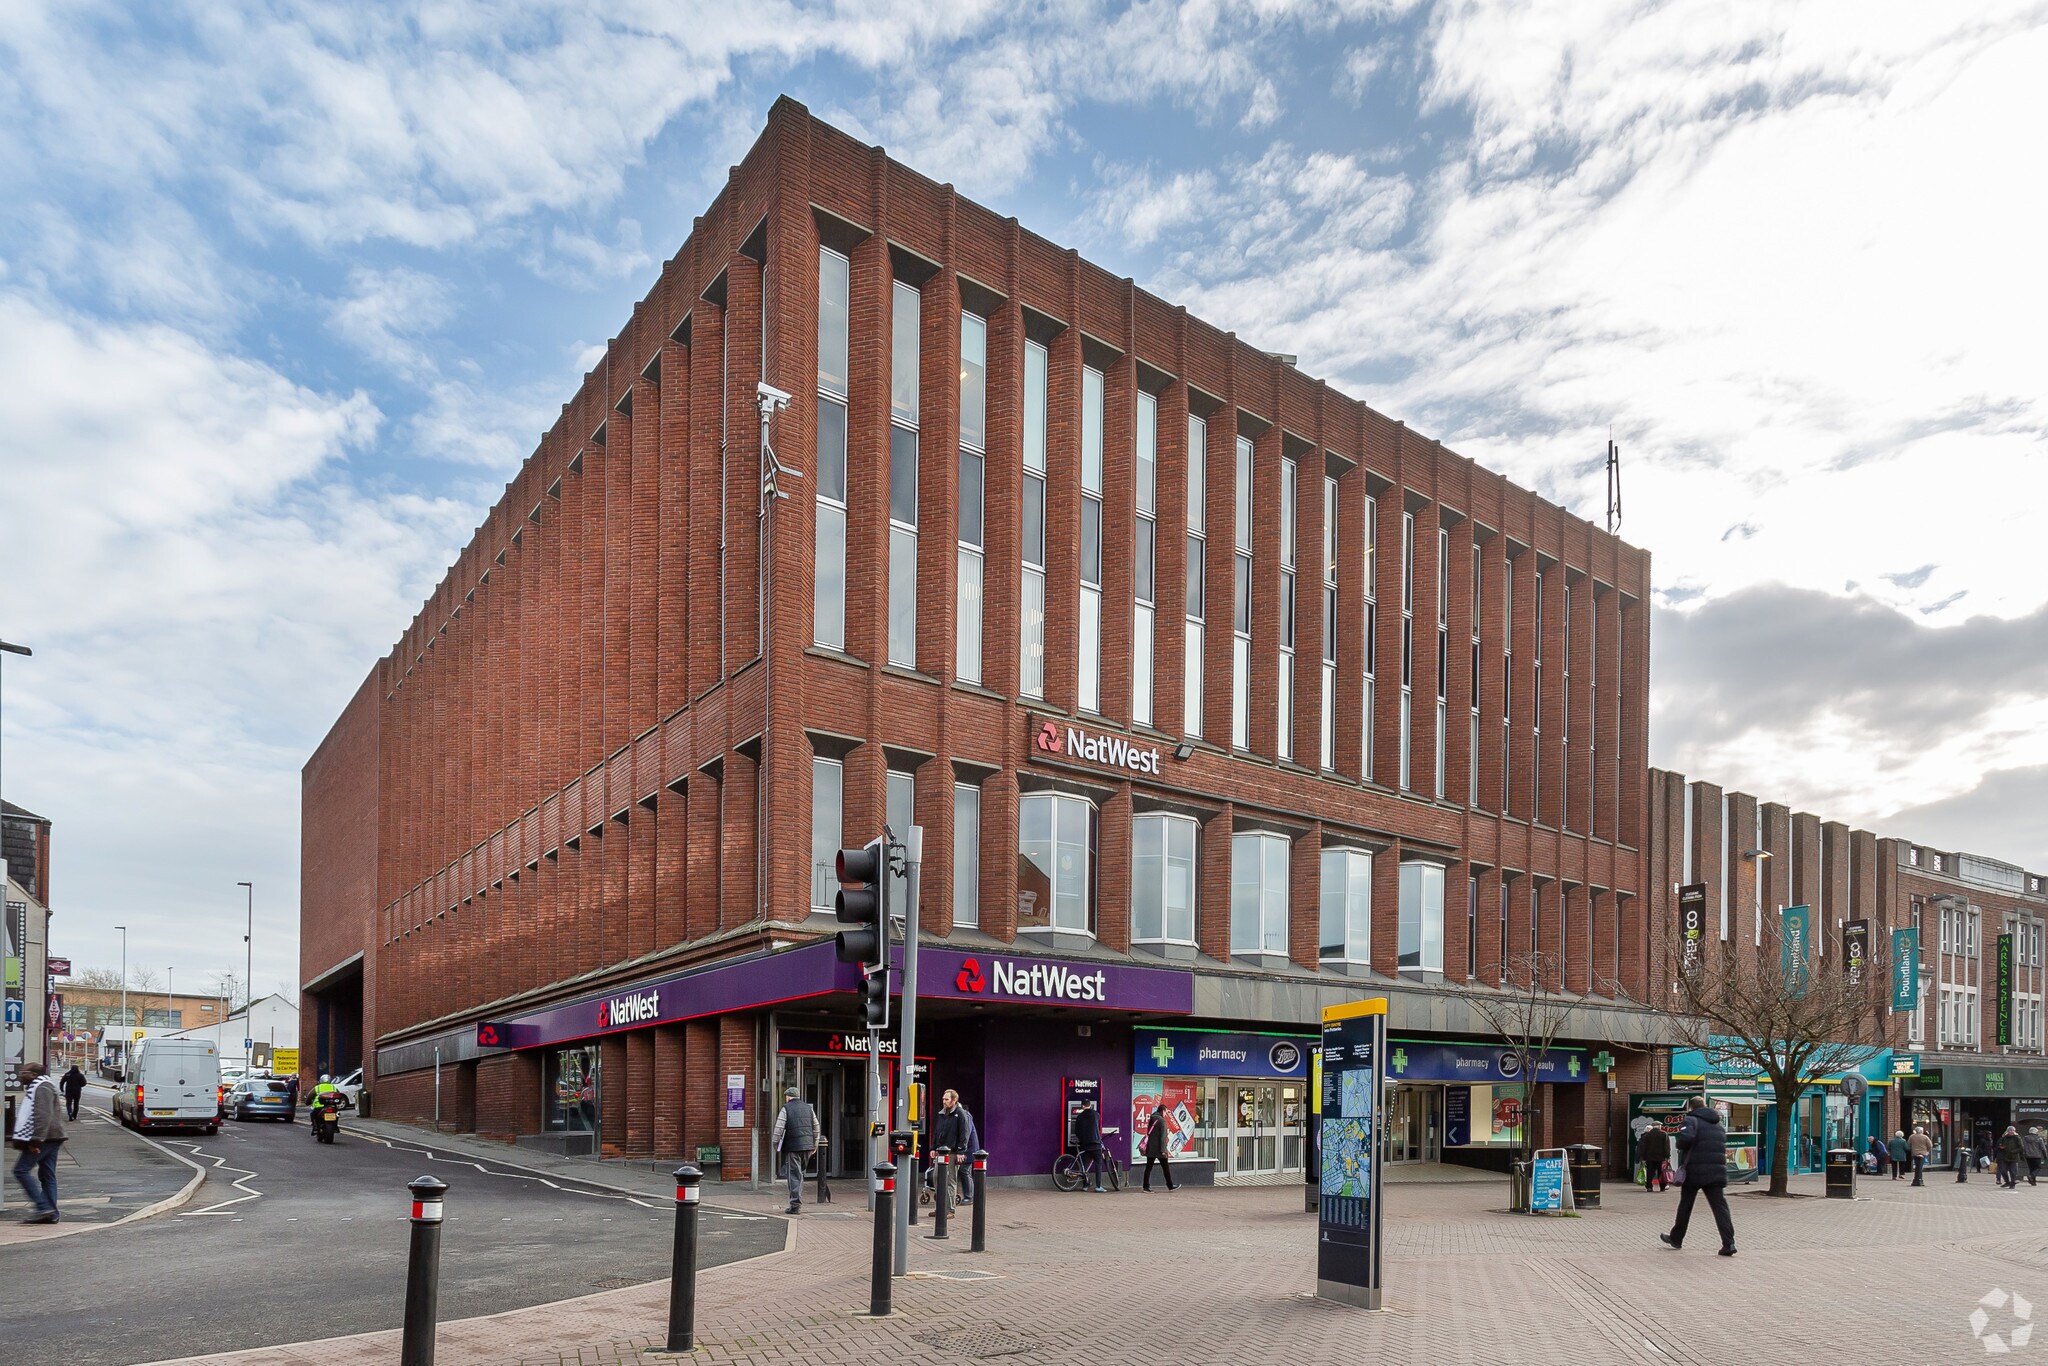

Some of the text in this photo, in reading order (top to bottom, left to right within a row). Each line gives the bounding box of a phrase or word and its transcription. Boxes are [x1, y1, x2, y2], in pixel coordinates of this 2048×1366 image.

[1067, 727, 1160, 775] NatWest
[993, 960, 1106, 1001] NatWest
[1899, 947, 1911, 998] Poundland
[1999, 937, 2009, 1043] MARKS & SPENCER
[610, 989, 659, 1026] NatWest
[1199, 1047, 1247, 1063] pharmacy
[1275, 1048, 1296, 1064] Boots
[1502, 1055, 1519, 1071] Boots
[1456, 1057, 1490, 1070] pharmacy
[1075, 1080, 1098, 1088] NatWest
[1985, 1082, 2005, 1091] SPENCER
[1545, 1160, 1562, 1169] CAFE
